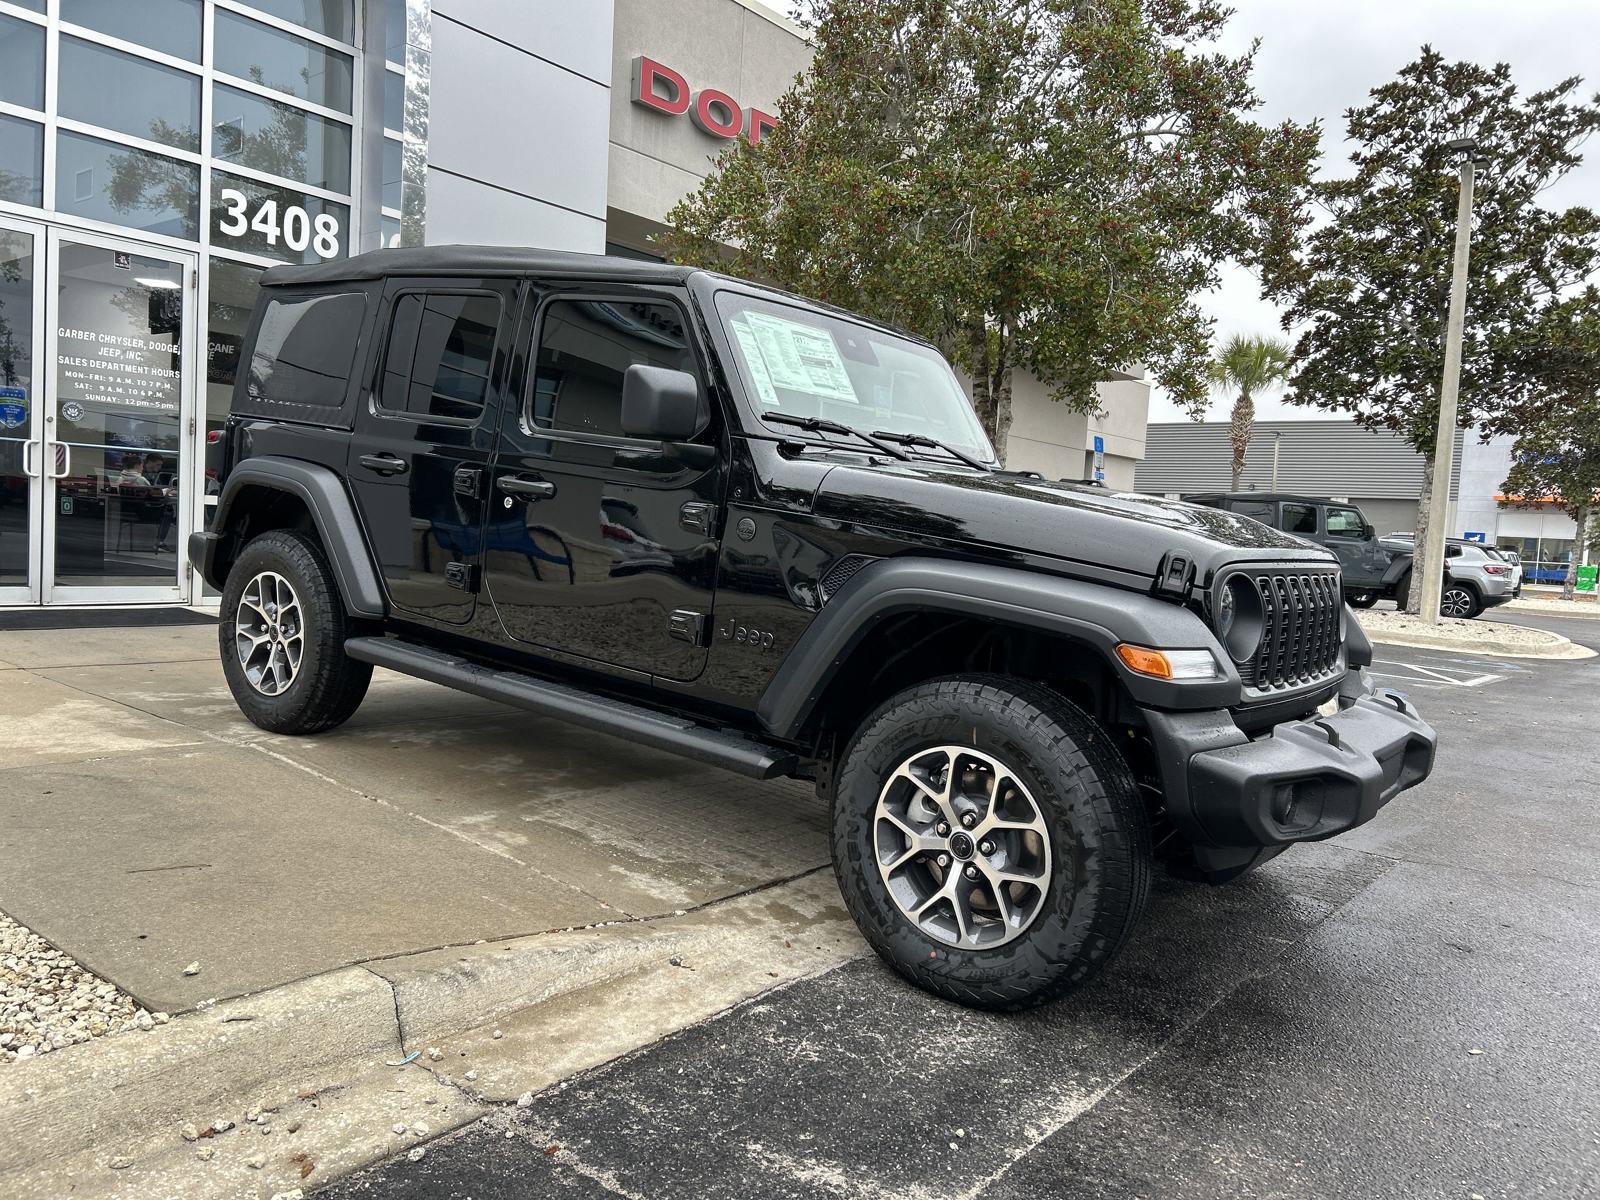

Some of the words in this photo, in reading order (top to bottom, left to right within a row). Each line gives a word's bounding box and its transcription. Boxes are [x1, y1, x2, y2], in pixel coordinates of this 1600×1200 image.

[219, 188, 340, 260] 3408
[58, 327, 96, 342] GARBER
[98, 333, 148, 351] CHRYSLER,
[208, 342, 235, 354] CANE
[98, 347, 124, 360] JEEP,
[126, 350, 144, 361] INC.
[58, 355, 88, 367] SALES
[90, 359, 149, 375] DEPARTMENT
[151, 367, 180, 379] HOURS
[73, 381, 93, 390] SAT:
[107, 386, 126, 394] A.M.
[147, 390, 166, 399] P.M.
[108, 375, 114, 383] 9
[116, 377, 135, 385] A.M.
[136, 379, 147, 387] TO
[155, 381, 174, 390] P.M.
[85, 393, 120, 404] SUNDAY:
[720, 618, 774, 652] Jeep
